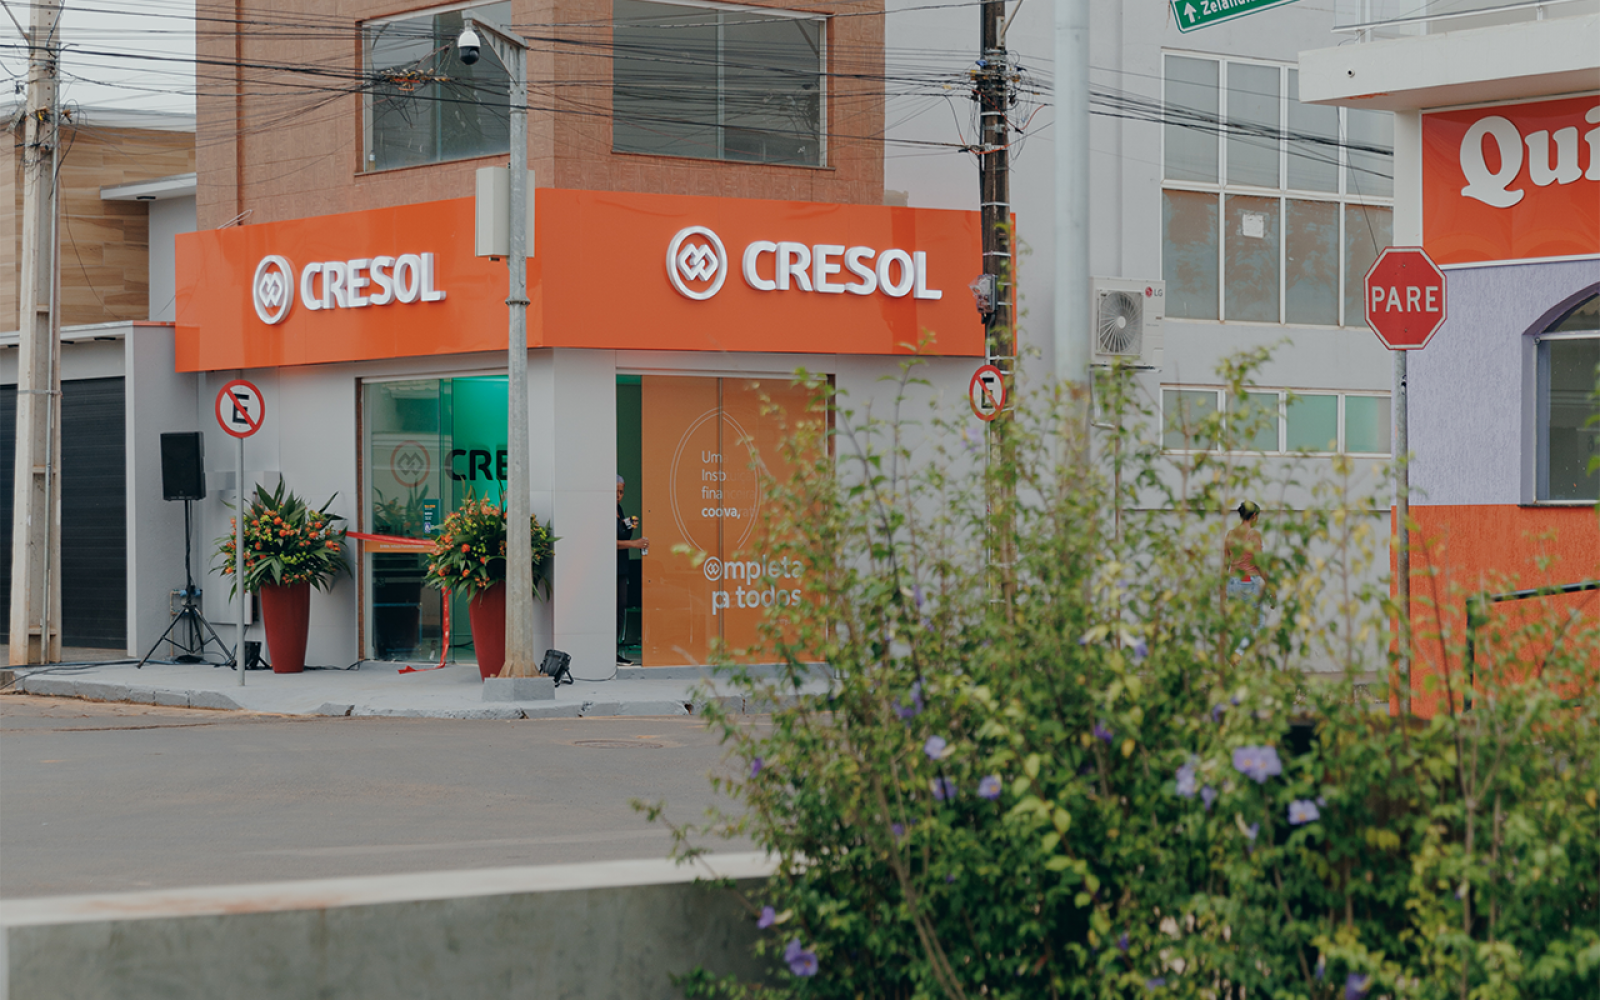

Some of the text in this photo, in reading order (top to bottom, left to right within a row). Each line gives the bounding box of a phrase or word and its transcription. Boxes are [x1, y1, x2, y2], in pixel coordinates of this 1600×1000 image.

[301, 252, 446, 311] CRESOL
[742, 240, 942, 299] CRESOL
[1153, 288, 1163, 297] LG
[1372, 286, 1439, 312] PARE
[232, 393, 250, 424] E
[735, 584, 802, 608] todos
